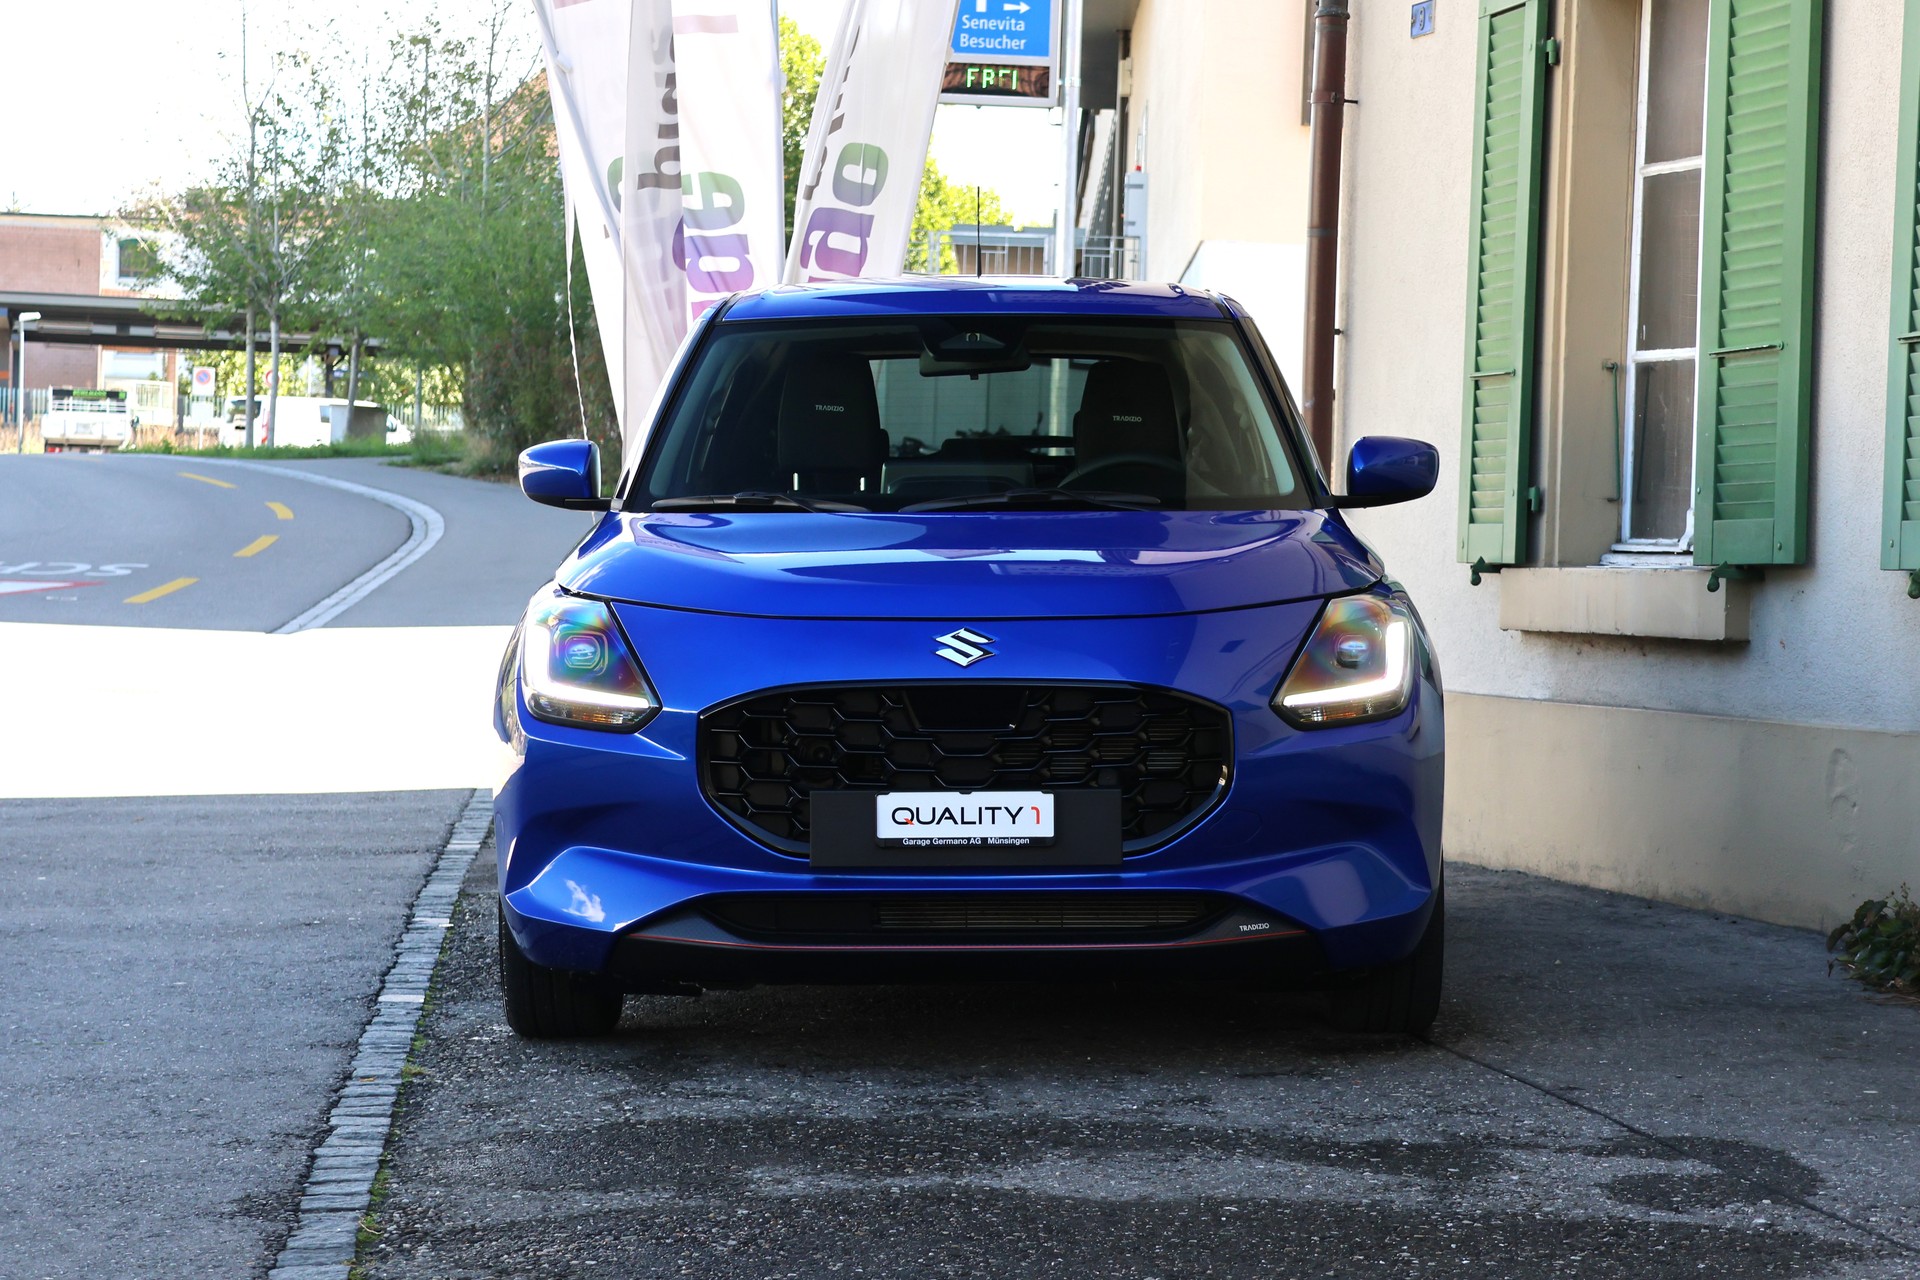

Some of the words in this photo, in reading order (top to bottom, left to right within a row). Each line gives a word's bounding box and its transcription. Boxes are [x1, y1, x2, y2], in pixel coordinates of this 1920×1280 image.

[961, 14, 1025, 31] Senevita
[959, 33, 1027, 50] Besucher
[815, 404, 845, 412] TRADIZIO
[1112, 415, 1142, 423] TRADIZIO
[891, 806, 1024, 826] QUALITY
[1030, 806, 1041, 825] 1
[902, 838, 931, 847] Garage
[932, 838, 968, 846] Germano
[969, 837, 982, 846] AG
[987, 837, 1030, 847] Münsingen
[1239, 922, 1270, 932] TRADIZIO
